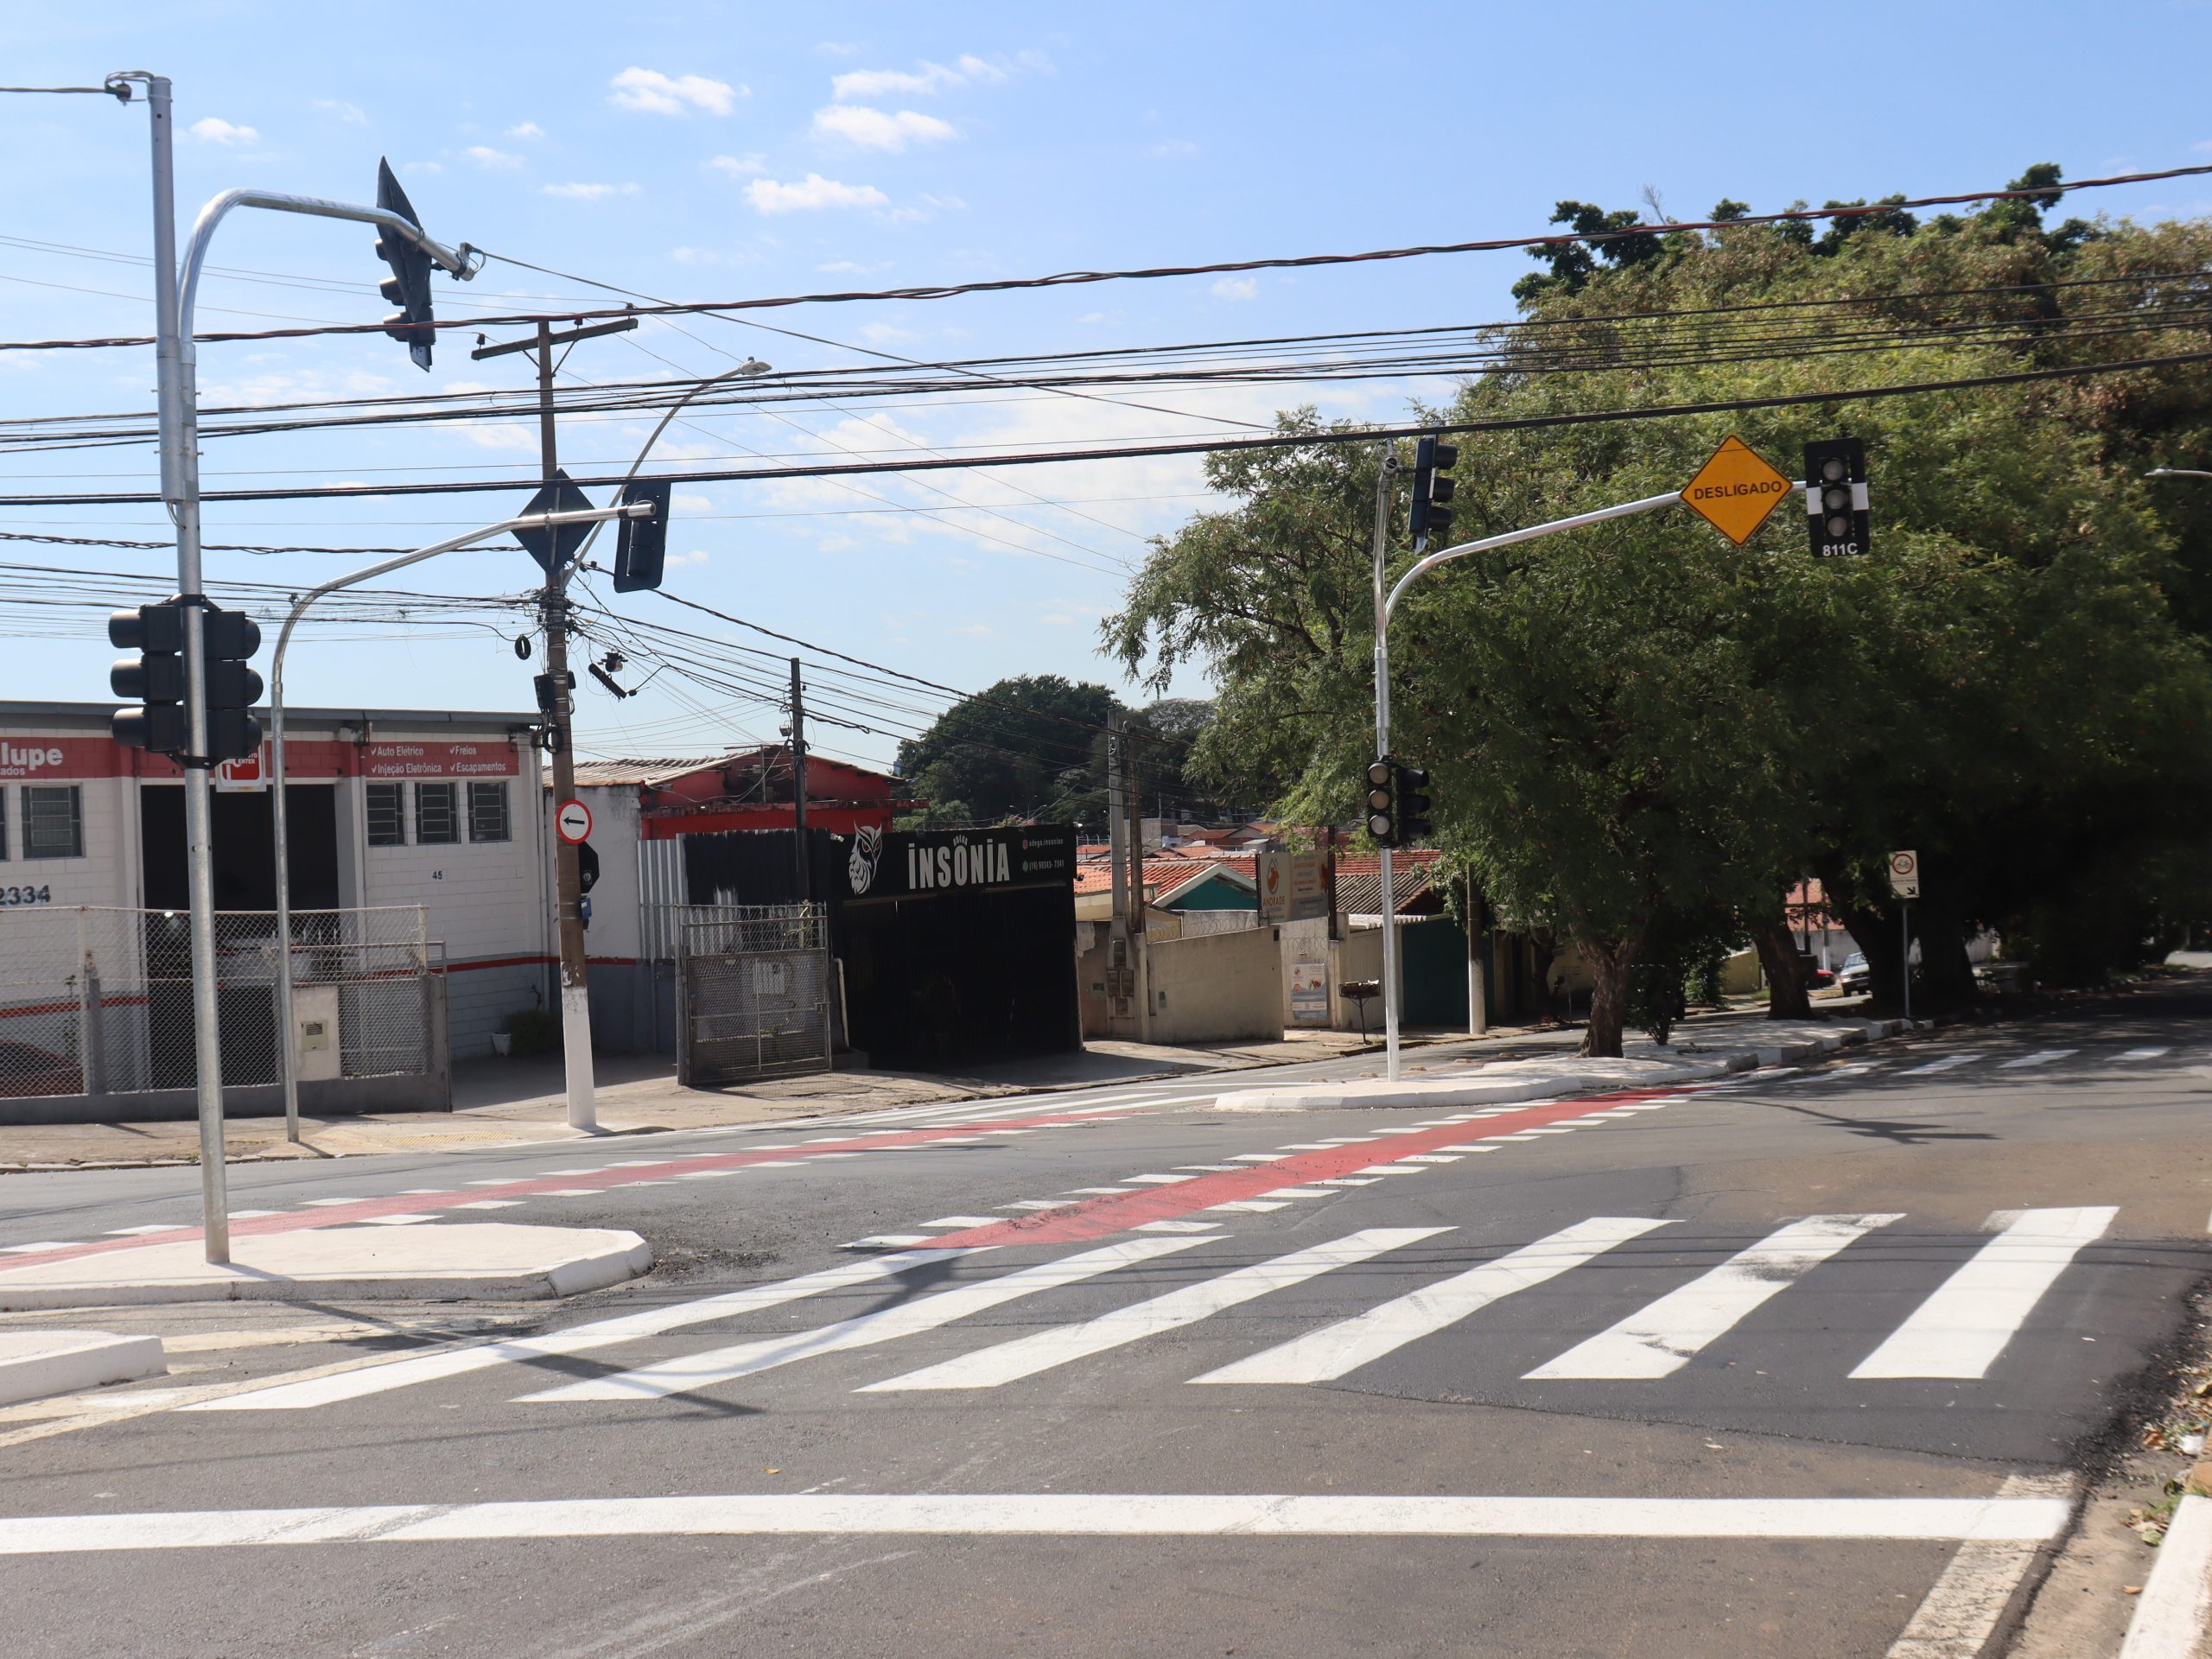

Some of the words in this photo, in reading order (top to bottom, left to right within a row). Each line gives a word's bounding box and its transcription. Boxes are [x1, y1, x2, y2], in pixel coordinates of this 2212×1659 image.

[1694, 480, 1782, 499] DESLIGADO
[1822, 543, 1858, 556] 811C
[377, 747, 395, 756] Auto
[397, 746, 424, 756] Elétrico
[455, 745, 477, 755] Freios
[377, 763, 404, 776] Injeção
[406, 763, 442, 773] Eletrônica
[456, 762, 506, 774] Escapamentos
[432, 870, 442, 880] 45
[1263, 896, 1285, 906] ANDRADE
